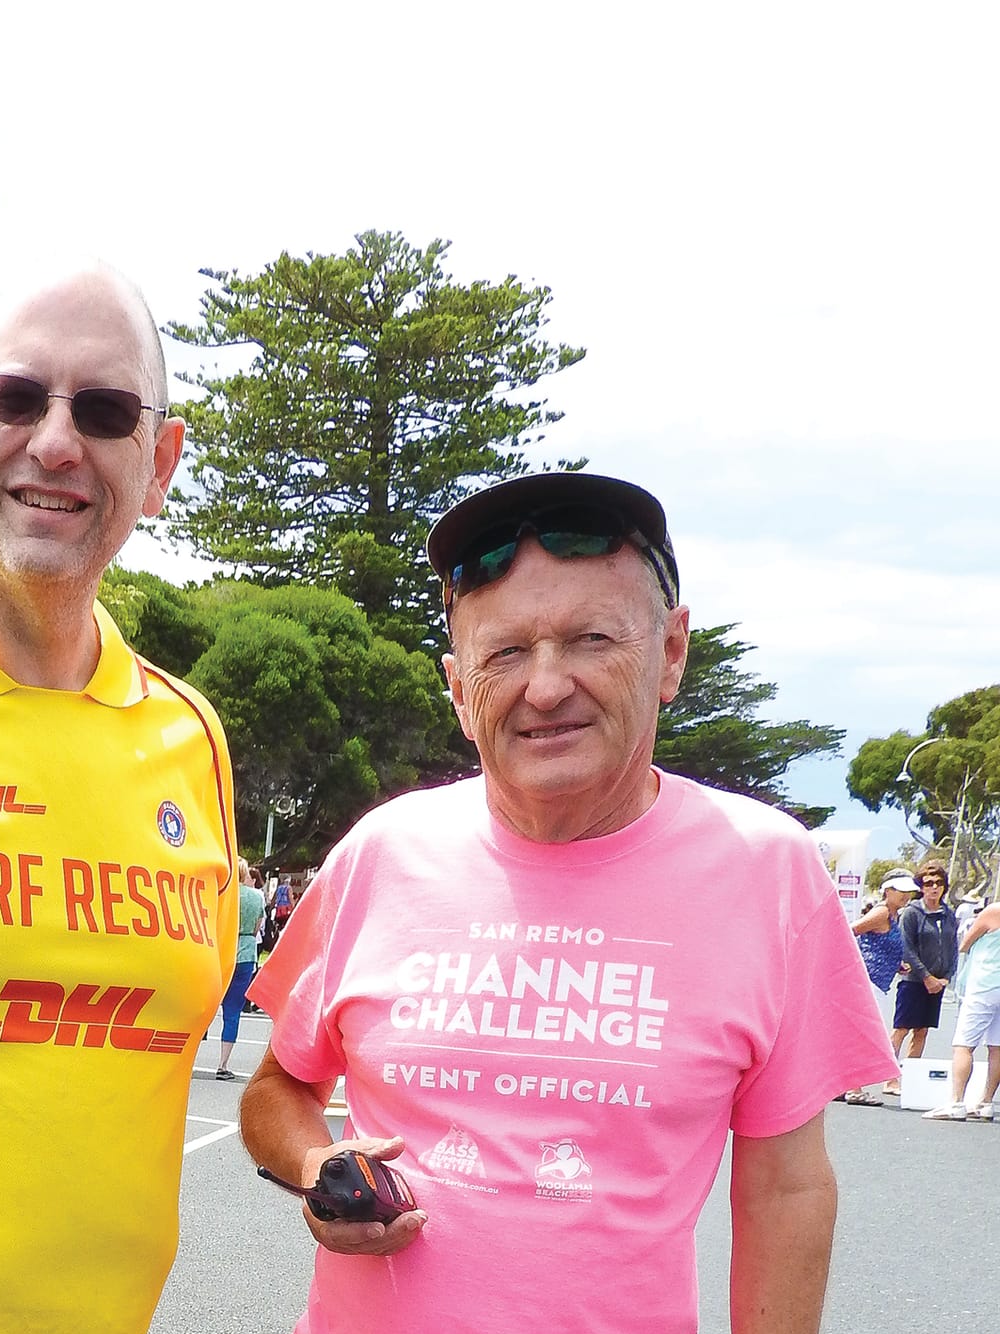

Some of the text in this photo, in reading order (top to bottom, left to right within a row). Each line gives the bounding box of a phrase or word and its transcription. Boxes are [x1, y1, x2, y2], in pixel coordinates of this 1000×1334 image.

[62, 858, 214, 947] RESCUE
[468, 922, 605, 946] SAN REMO
[395, 952, 669, 1012] CHANNEL
[389, 996, 665, 1050] CHALLENGE
[382, 1063, 652, 1108] EVENT OFFICIAL
[434, 1142, 479, 1159] BASS
